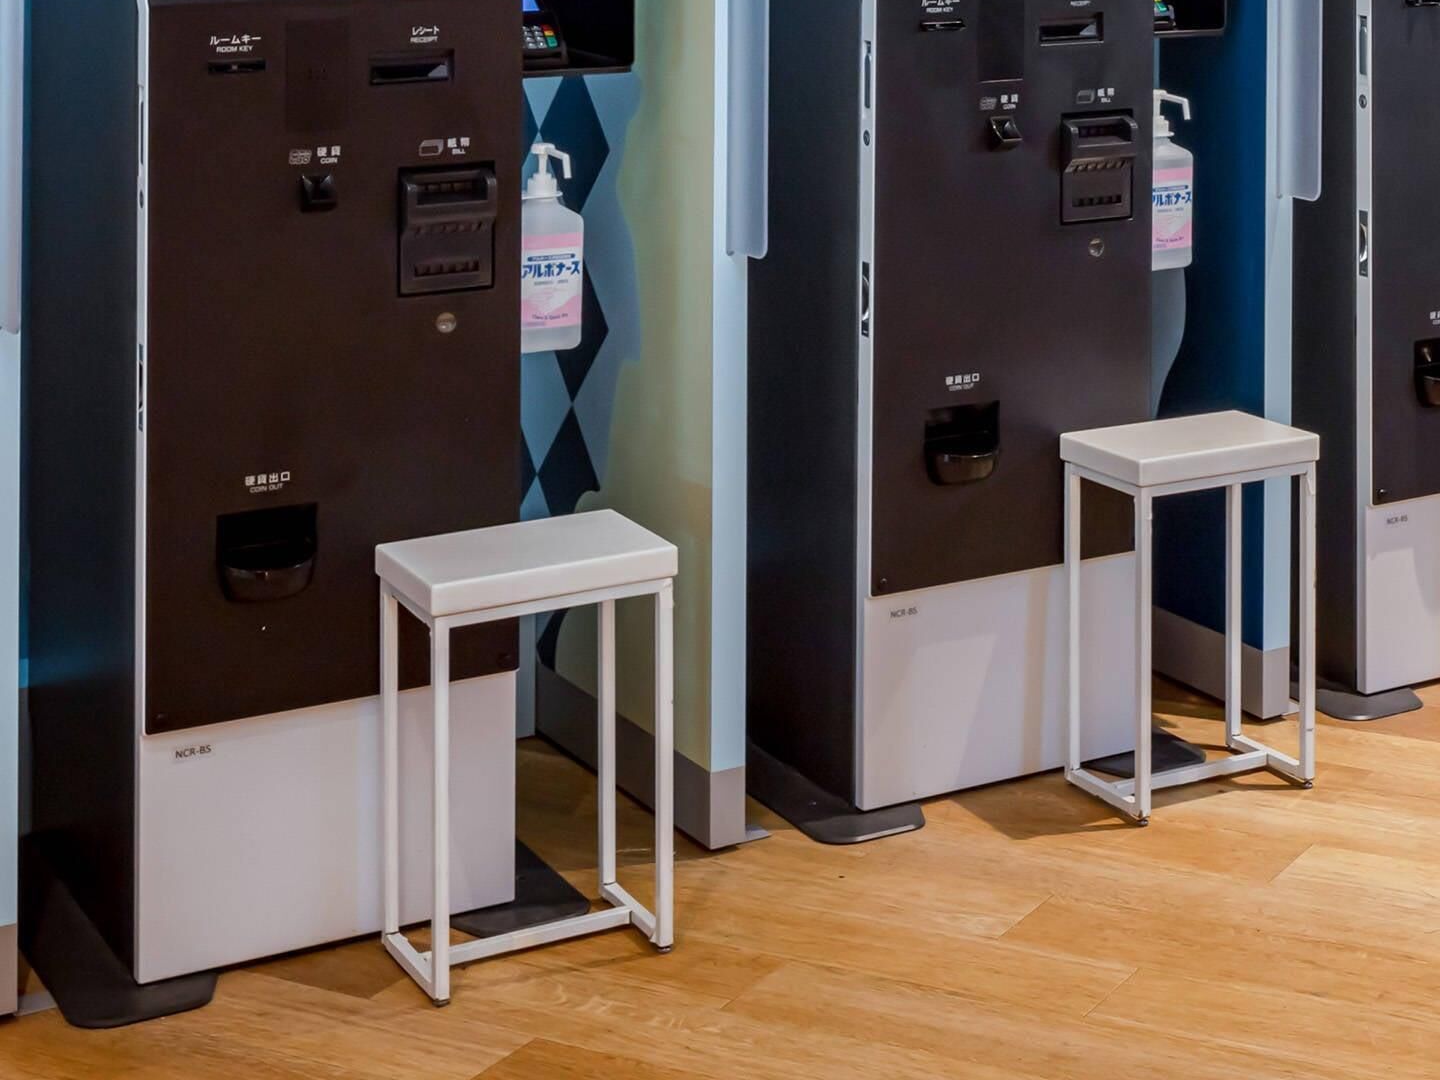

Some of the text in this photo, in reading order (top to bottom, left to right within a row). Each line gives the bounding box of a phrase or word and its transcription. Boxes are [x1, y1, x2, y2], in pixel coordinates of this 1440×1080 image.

[411, 25, 440, 36] レシート
[209, 34, 262, 46] ルームキー
[216, 45, 237, 53] ROOM
[522, 260, 581, 279] アルボナース
[249, 482, 284, 493] COIN OUT
